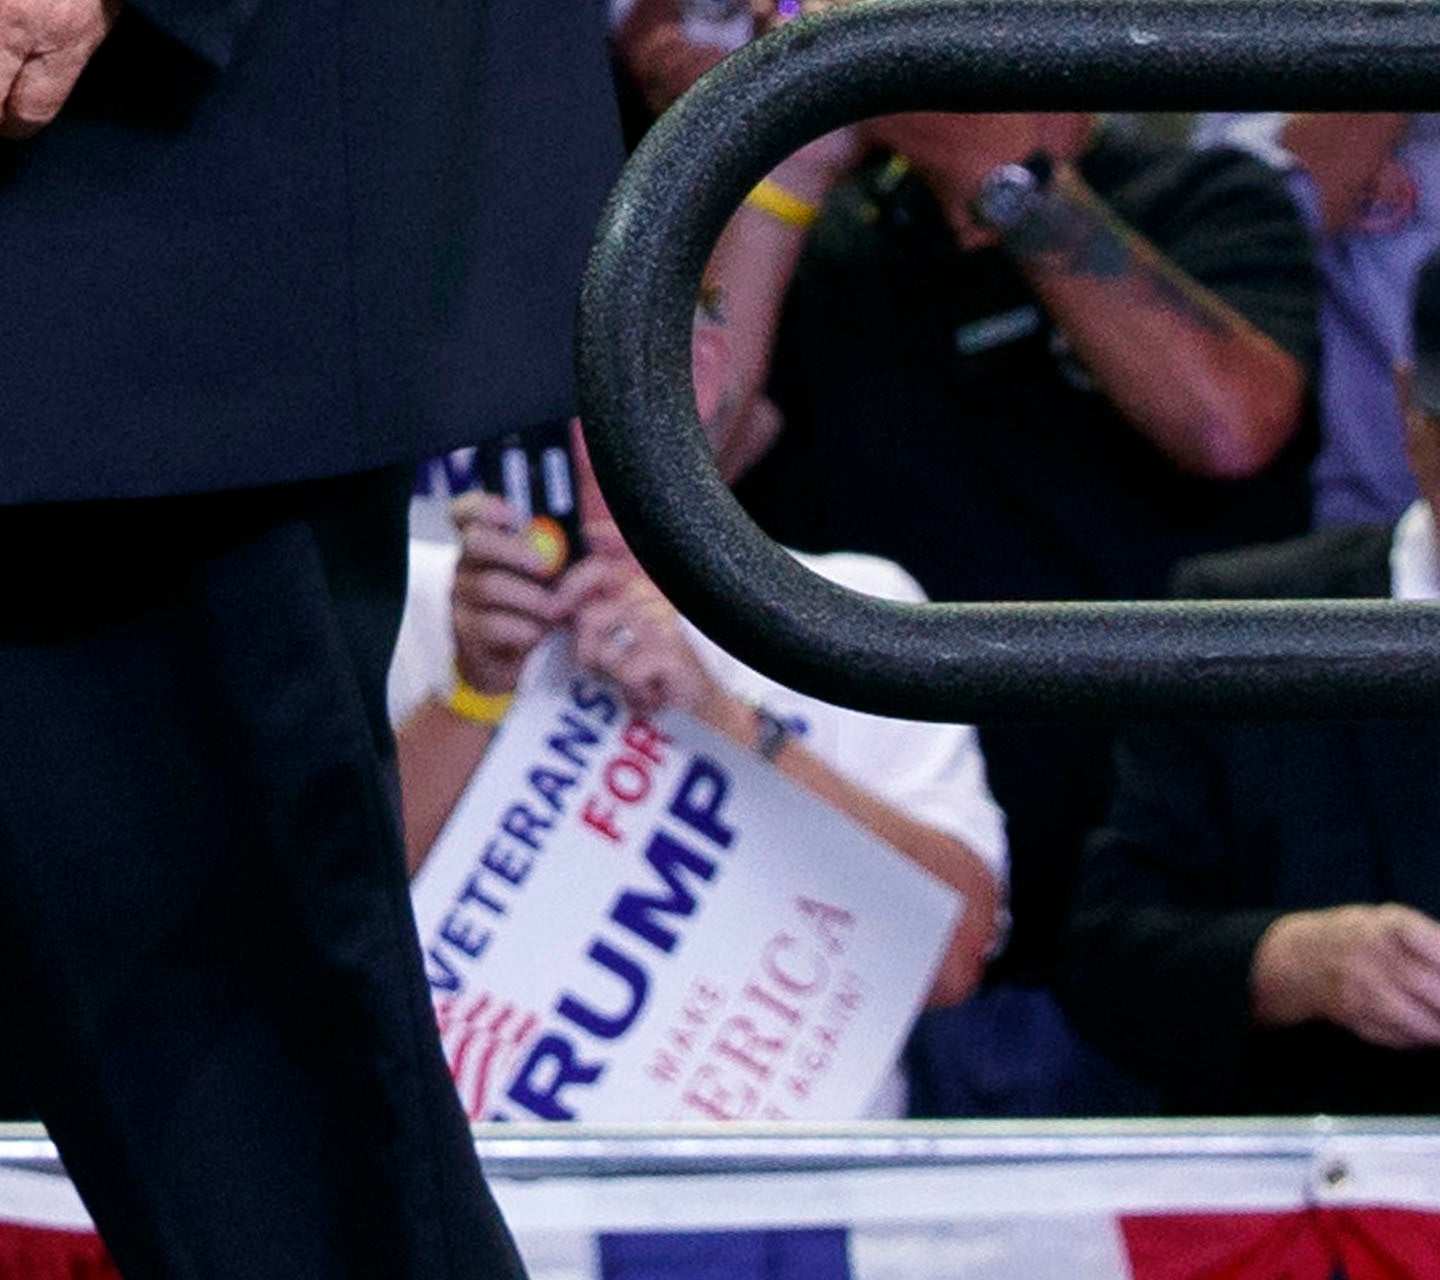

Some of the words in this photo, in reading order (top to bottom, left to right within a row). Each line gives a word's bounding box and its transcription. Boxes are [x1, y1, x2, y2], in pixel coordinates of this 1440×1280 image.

[424, 680, 622, 994] VETERANS
[580, 716, 674, 844] FOR
[490, 754, 736, 1122] RUMP
